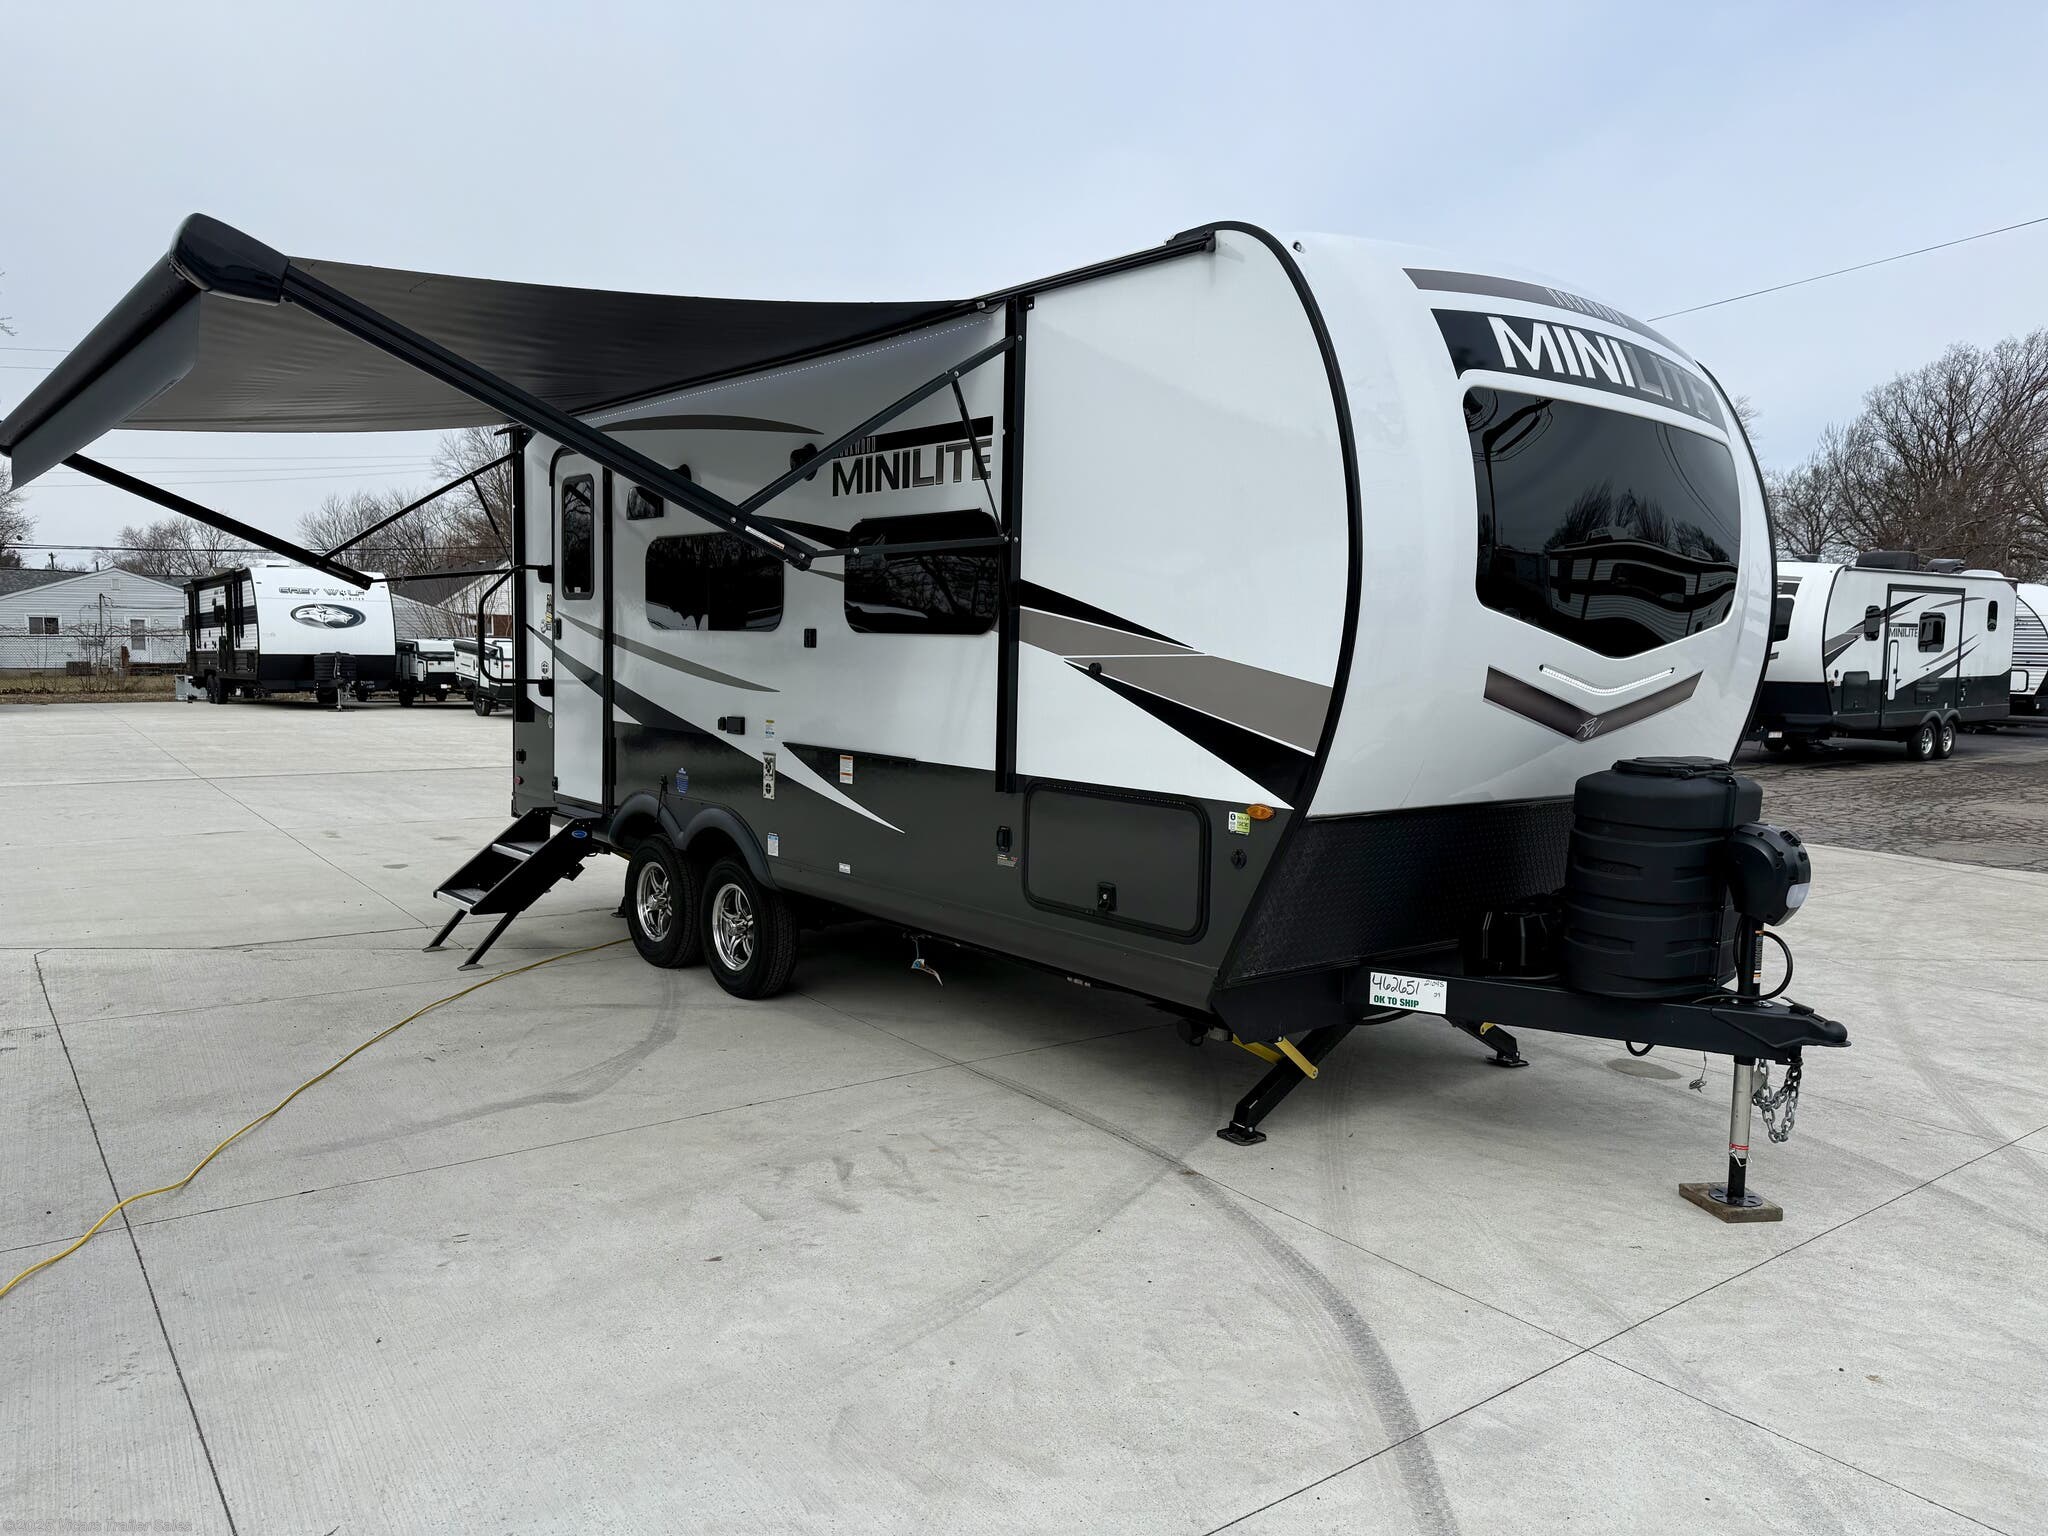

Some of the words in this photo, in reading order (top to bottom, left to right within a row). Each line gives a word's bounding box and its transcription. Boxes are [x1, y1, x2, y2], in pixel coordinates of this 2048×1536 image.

[1487, 316, 1712, 420] MINILITE
[833, 438, 992, 497] MINILITE
[1888, 627, 1918, 638] MINILITE
[1371, 973, 1420, 995] 462651
[1373, 994, 1386, 1004] OK
[1388, 996, 1398, 1006] TO
[1399, 998, 1419, 1008] SHIP
